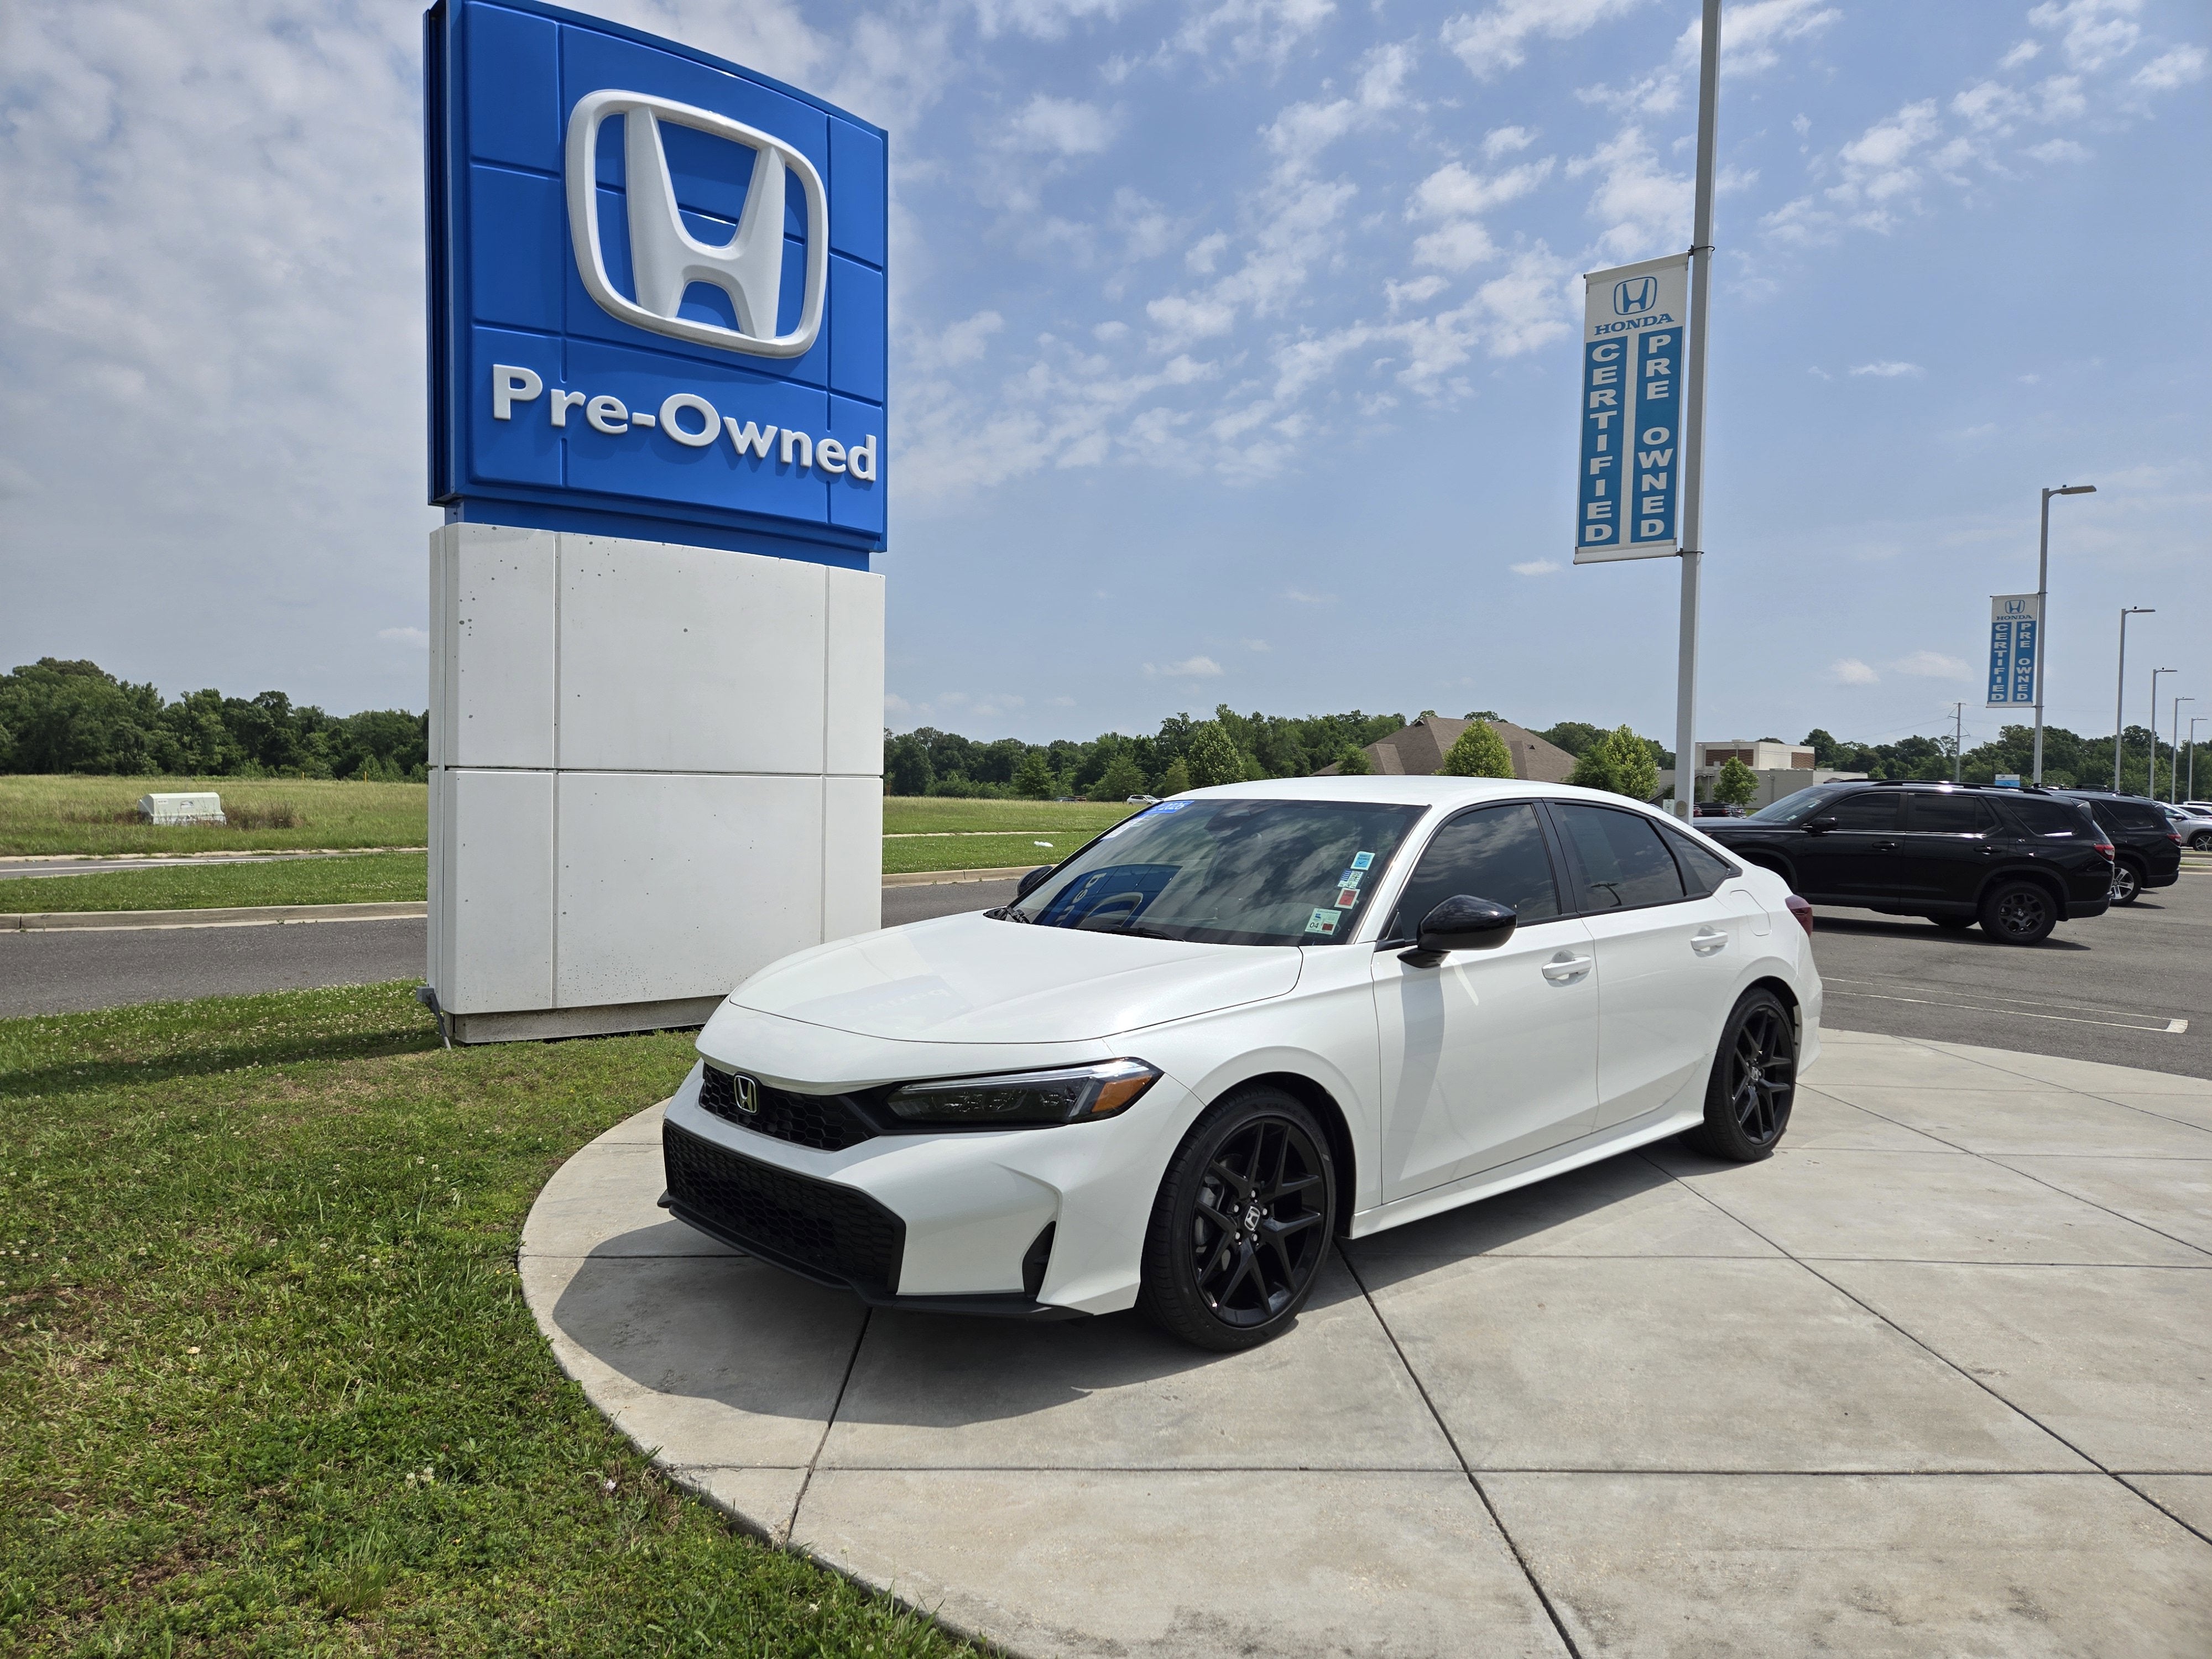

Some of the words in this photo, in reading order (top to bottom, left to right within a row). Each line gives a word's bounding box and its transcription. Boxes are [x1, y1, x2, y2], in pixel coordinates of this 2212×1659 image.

[1594, 313, 1674, 335] HONDA
[1646, 334, 1672, 400] PRE
[492, 363, 877, 482] Pre-Owned
[1585, 343, 1621, 542] CERTIFIED
[1637, 426, 1674, 538] OWNED
[1991, 623, 2008, 701] CERTIFIED
[2020, 623, 2032, 648] PRE
[2016, 658, 2032, 701] OWNED
